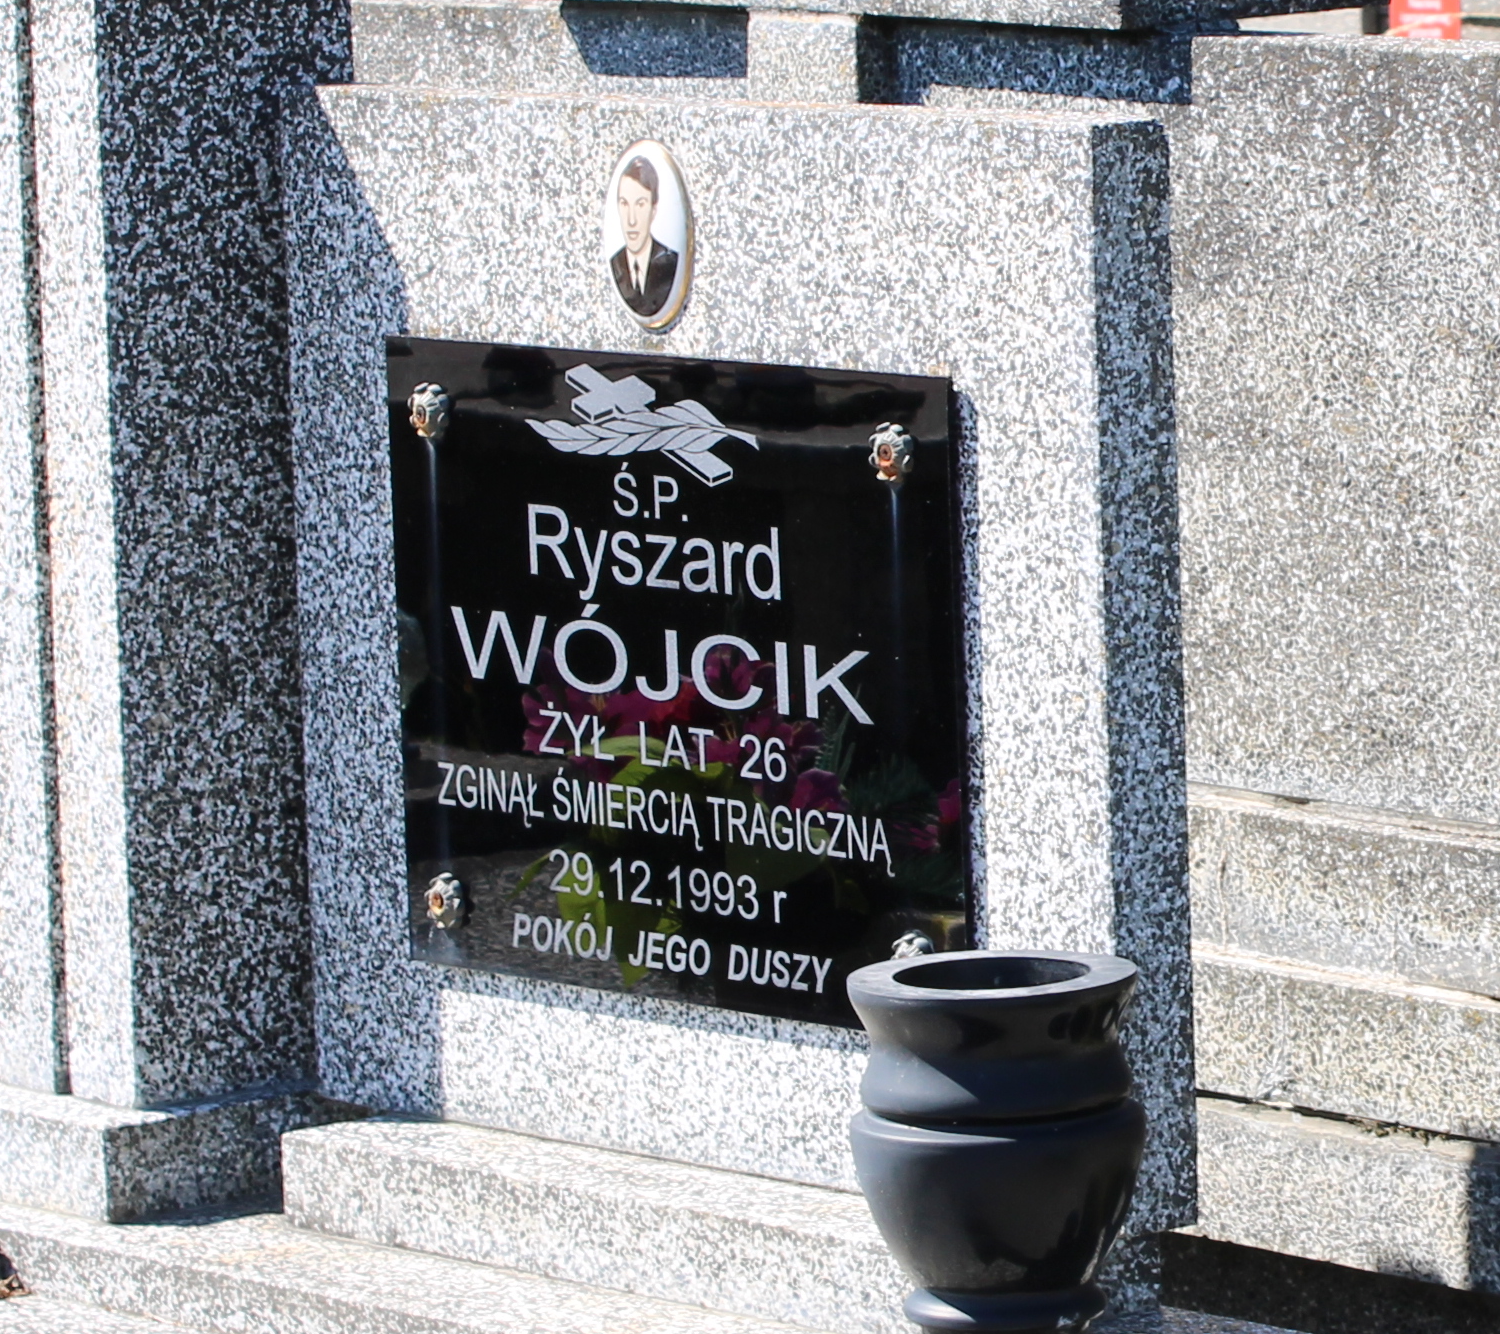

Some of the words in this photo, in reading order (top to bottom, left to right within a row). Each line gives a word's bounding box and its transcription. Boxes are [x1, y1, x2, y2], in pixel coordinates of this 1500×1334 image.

[613, 461, 688, 522] Ś.P.
[527, 503, 781, 601] Ryszard
[450, 603, 874, 725] WÓJCIK
[539, 701, 615, 761] ŻYŁ
[639, 720, 715, 773] LAT
[739, 733, 787, 782] 26
[437, 761, 545, 828] ZGINĄŁ
[552, 776, 704, 852] ŚMIERCIĄ
[706, 796, 895, 877] TRAGICZNĄ
[549, 848, 759, 920] 29.12.1993
[773, 890, 787, 924] r
[511, 912, 613, 962] POKÓJ
[628, 930, 711, 976] JEGO
[727, 943, 833, 994] DUSZY
